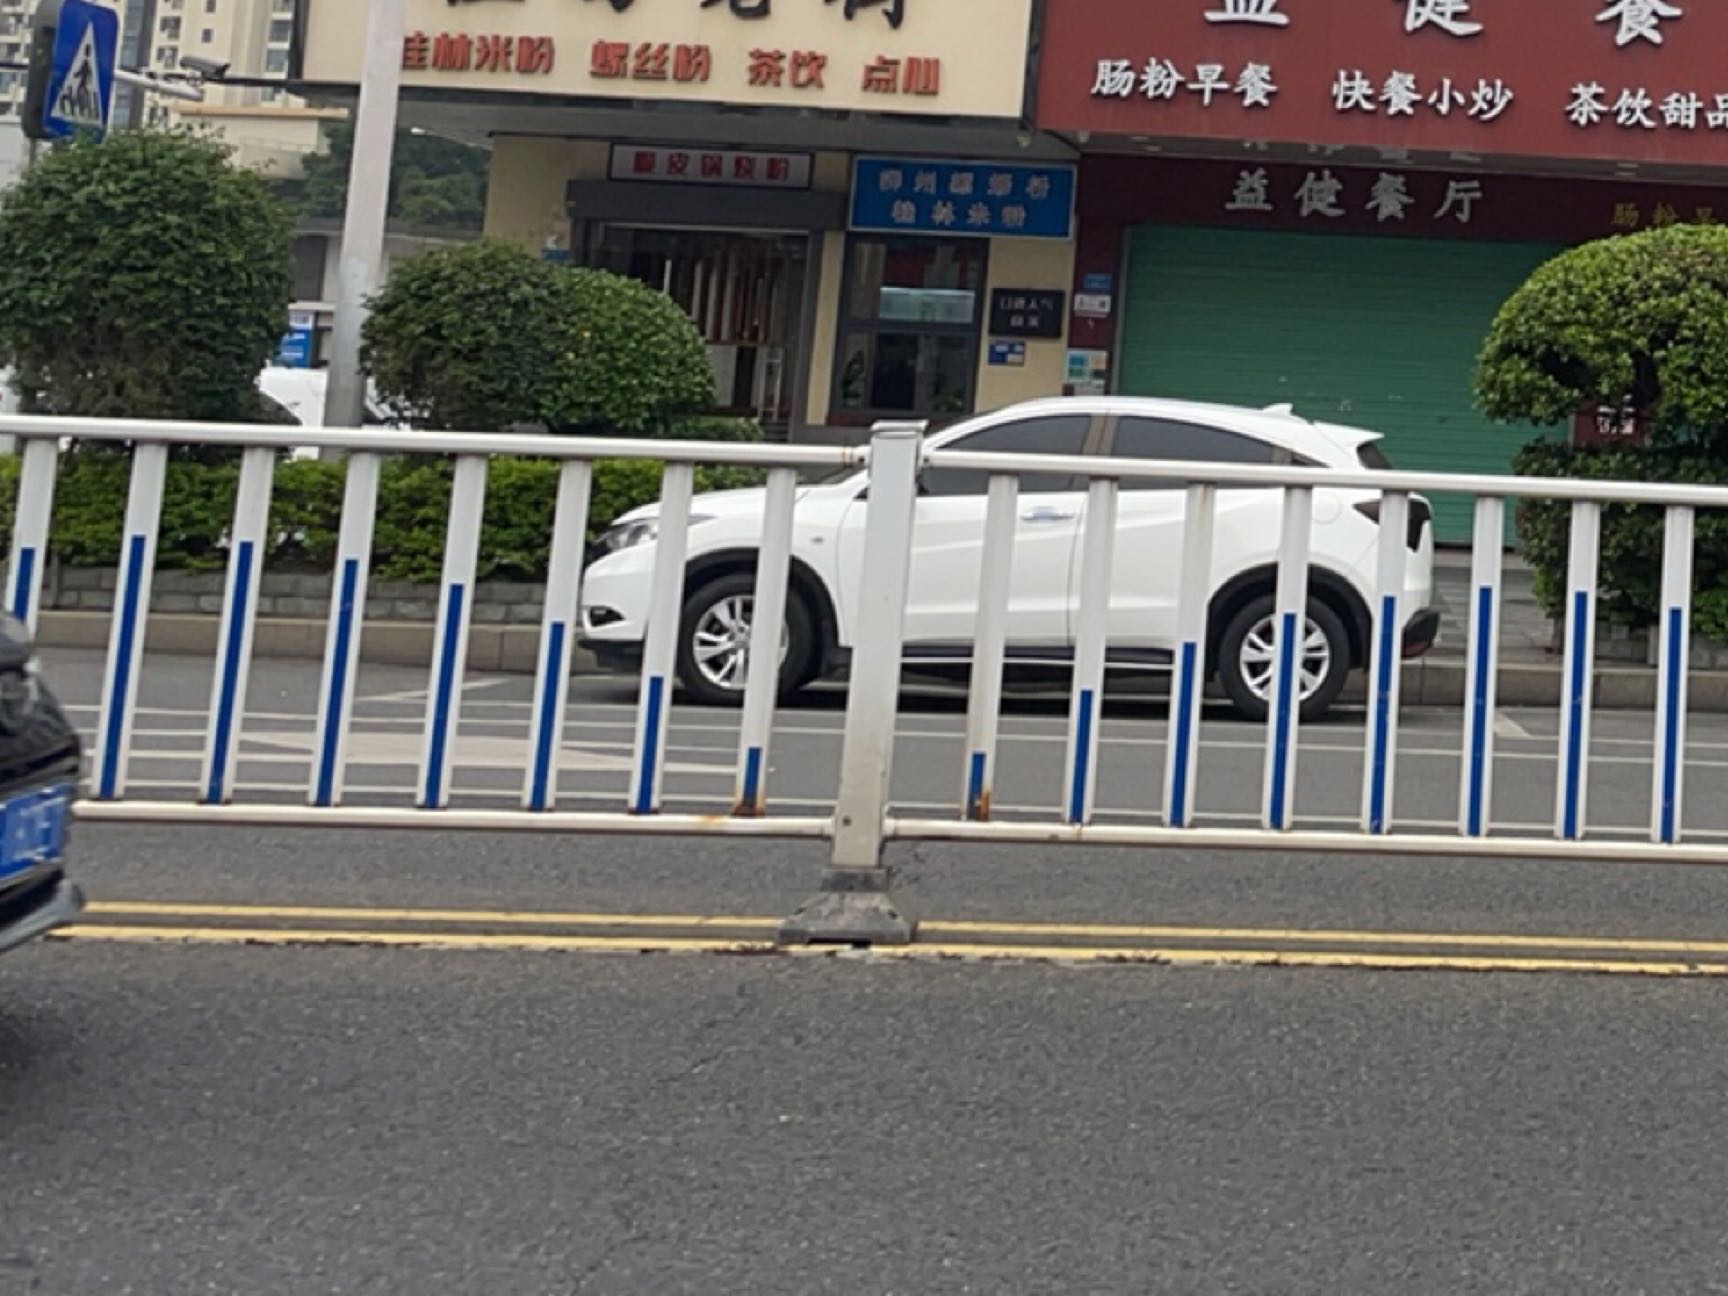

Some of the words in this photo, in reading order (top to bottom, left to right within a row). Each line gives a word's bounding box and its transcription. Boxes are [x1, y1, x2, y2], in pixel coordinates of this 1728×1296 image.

[590, 38, 712, 83] 螺丝粉
[747, 47, 829, 91] 茶饮
[1091, 58, 1280, 108] 肠粉早餐
[1332, 69, 1514, 121] 快餐小炒
[1225, 167, 1483, 223] 益健餐厅
